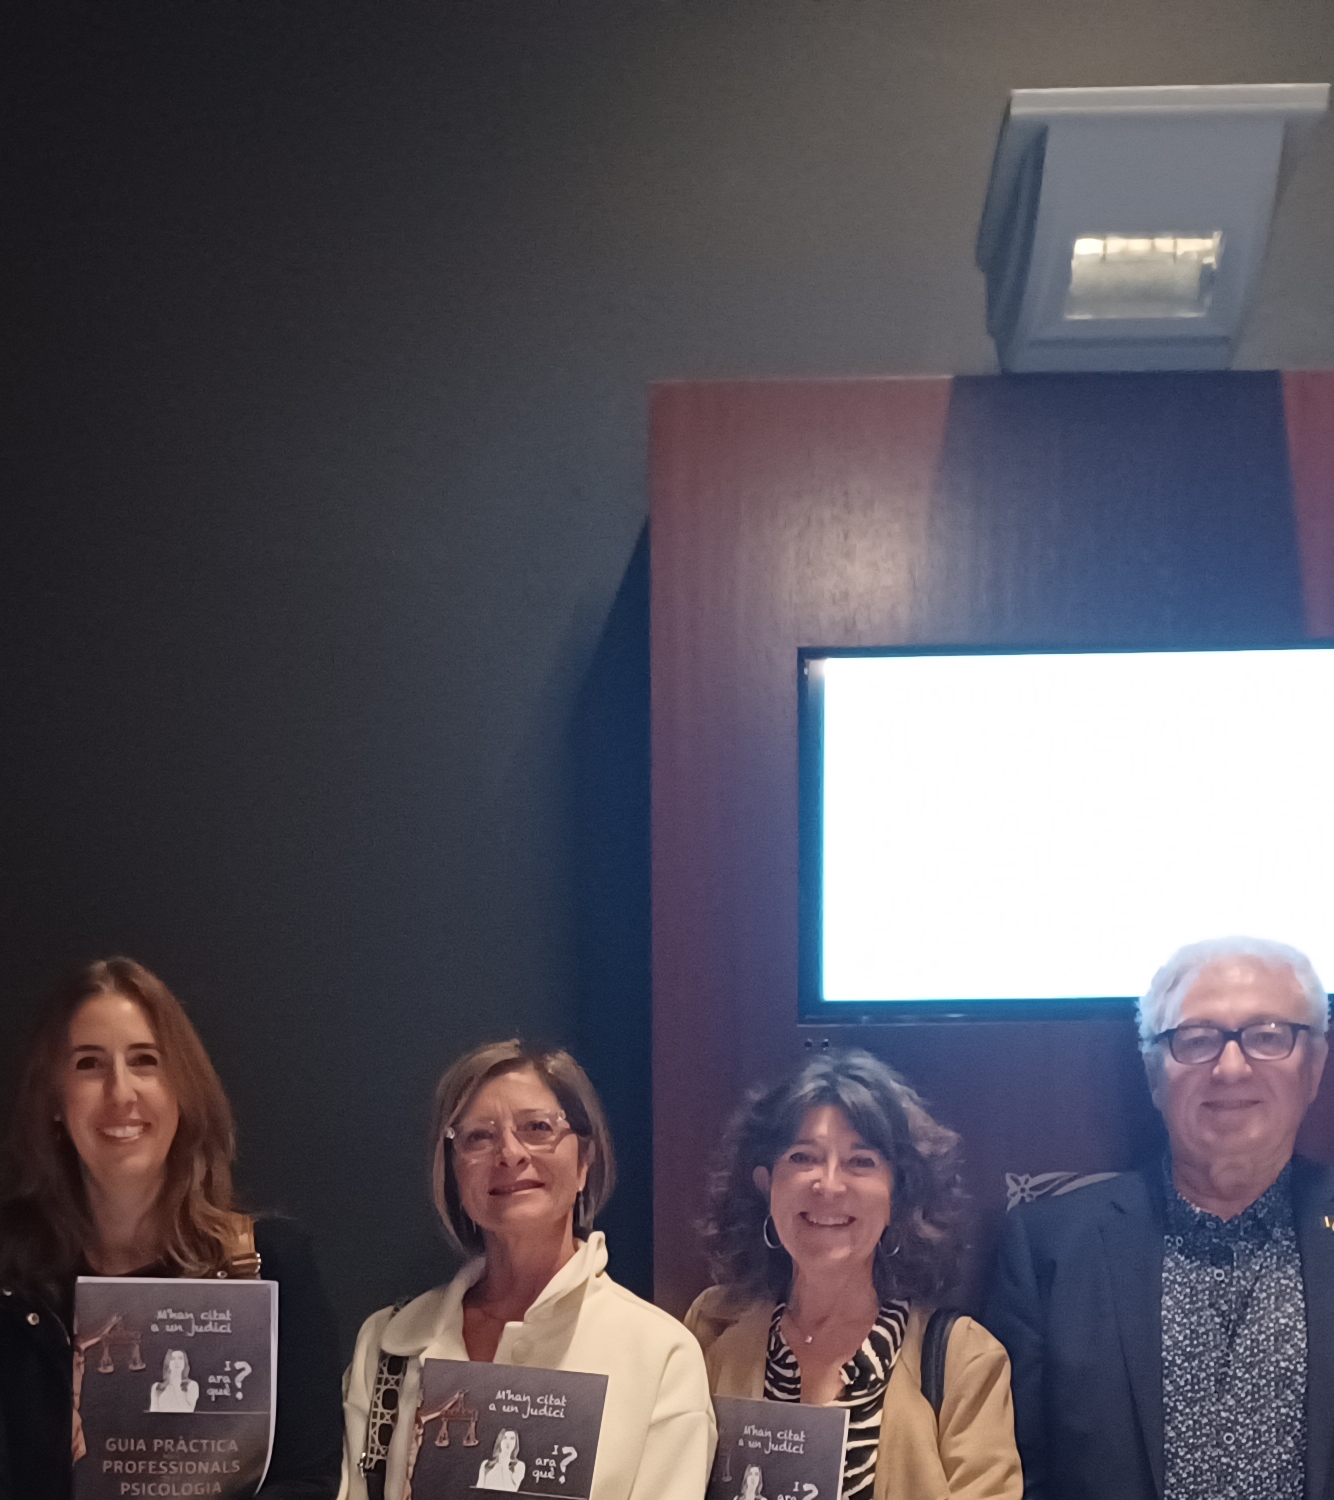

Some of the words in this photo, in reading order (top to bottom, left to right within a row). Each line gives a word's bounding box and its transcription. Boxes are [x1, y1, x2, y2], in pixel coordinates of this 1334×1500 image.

[208, 1375, 231, 1383] ara
[537, 1394, 567, 1406] citat
[488, 1403, 496, 1411] a
[502, 1405, 519, 1413] un
[106, 1438, 146, 1452] GUIA
[153, 1436, 238, 1453] PRÀCTICA
[102, 1460, 241, 1474] PROFESSIONALS
[535, 1457, 556, 1467] ara
[120, 1481, 222, 1496] PSICOLOGIA
